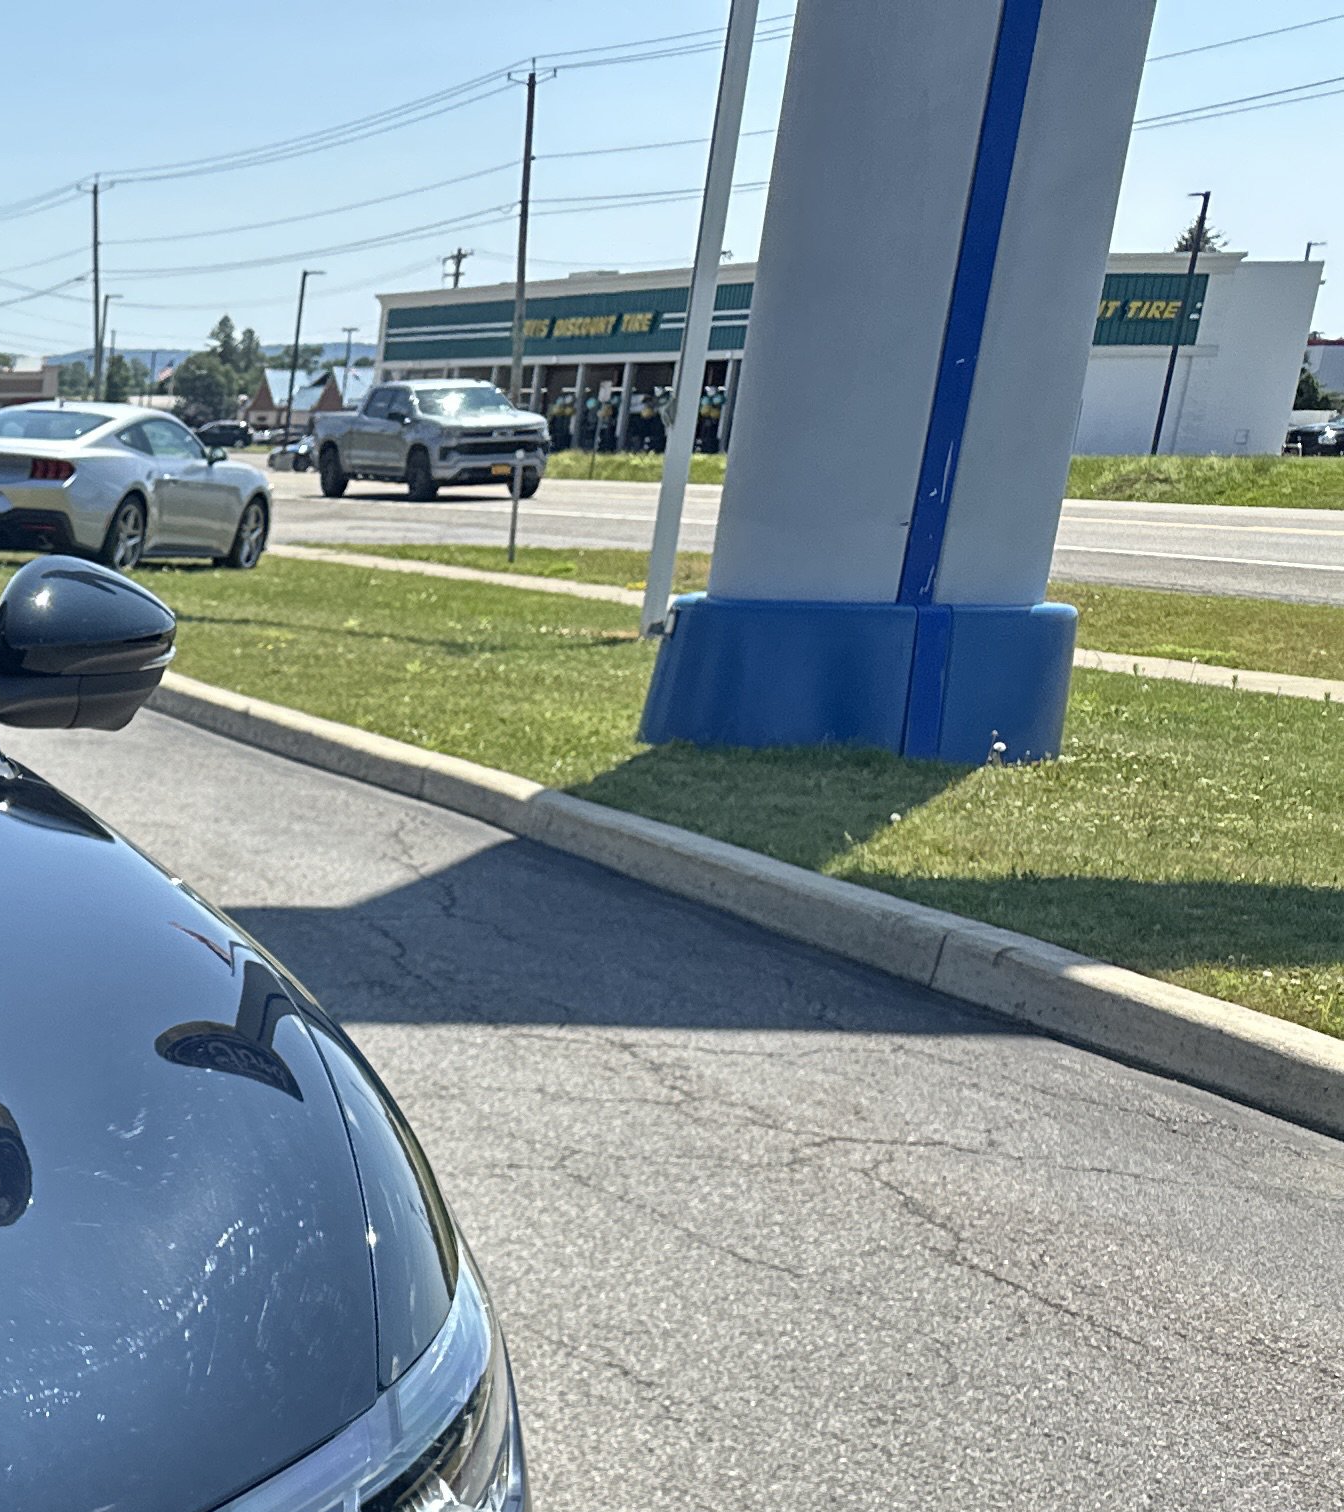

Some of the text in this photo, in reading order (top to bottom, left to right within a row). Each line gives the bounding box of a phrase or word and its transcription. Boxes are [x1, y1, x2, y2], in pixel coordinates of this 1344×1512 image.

[1127, 300, 1182, 319] TIRE
[553, 315, 617, 337] DISCOUNT
[621, 312, 653, 333] TIRE
